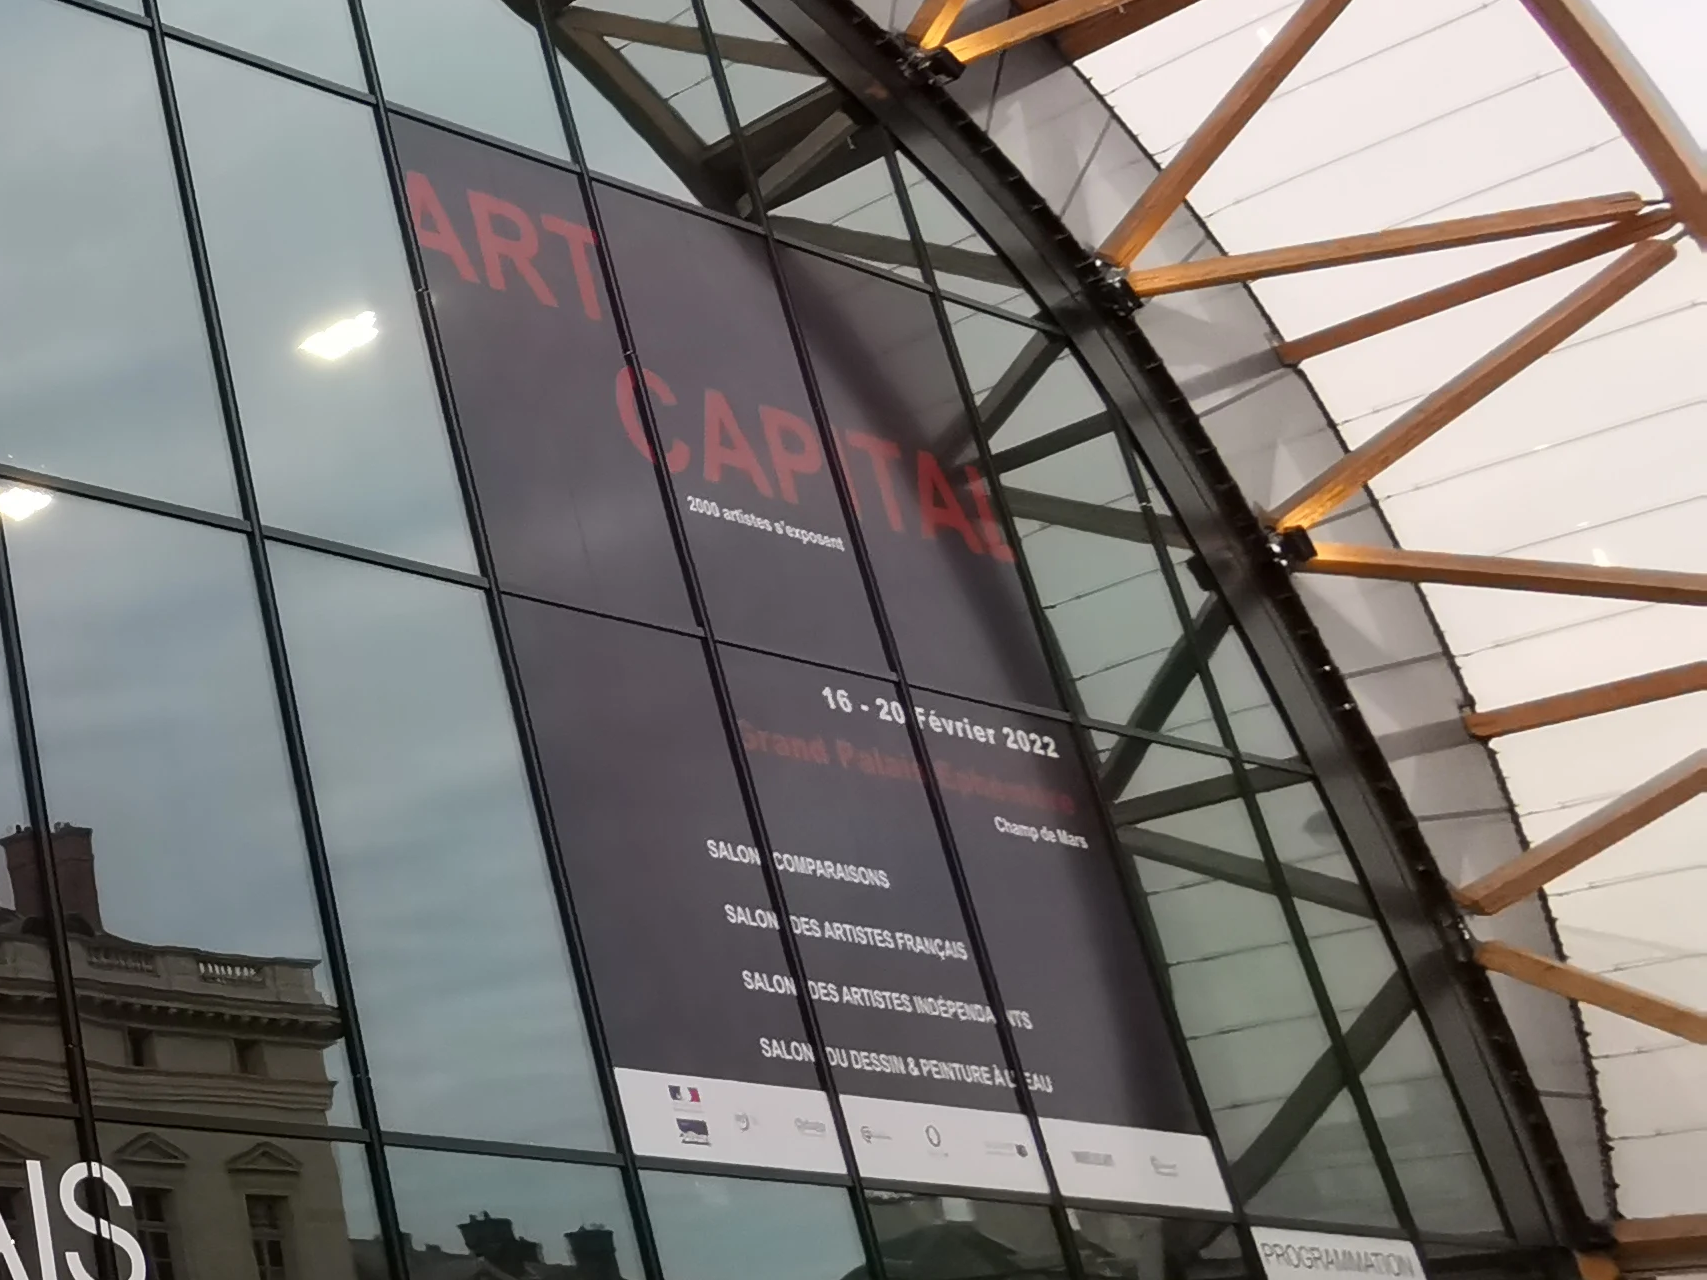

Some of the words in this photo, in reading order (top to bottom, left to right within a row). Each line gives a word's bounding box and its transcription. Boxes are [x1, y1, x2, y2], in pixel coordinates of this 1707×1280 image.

[406, 170, 602, 320] ART
[615, 366, 1018, 562] CAPITAL
[687, 495, 721, 518] 2000
[721, 508, 773, 532] artistes
[773, 520, 845, 552] s'exposent
[822, 686, 853, 713] 16
[875, 697, 906, 724] 20
[914, 705, 996, 746] Février
[1002, 726, 1060, 759] 2022
[837, 739, 928, 784] Palai
[994, 816, 1039, 842] Champ
[1040, 825, 1057, 843] de
[1056, 828, 1089, 850] Mars
[706, 839, 761, 866] SALON
[773, 851, 890, 888] COMPARAISONS
[724, 903, 781, 930] SALON
[789, 915, 822, 938] DES
[823, 922, 894, 950] ARTISTES
[895, 931, 968, 960] FRANÇAIS
[742, 970, 797, 996] SALON
[808, 980, 840, 1003] DES
[842, 985, 912, 1013] ARTISTES
[759, 1037, 816, 1064] SALON
[825, 1046, 849, 1068] DU
[849, 1049, 906, 1074] DESSIN
[907, 1056, 921, 1076] &
[919, 1058, 993, 1086] PEINTURE
[992, 1063, 1007, 1087] À
[1004, 1068, 1053, 1094] L'EAU
[1260, 1242, 1416, 1278] PROGRAMMATION
